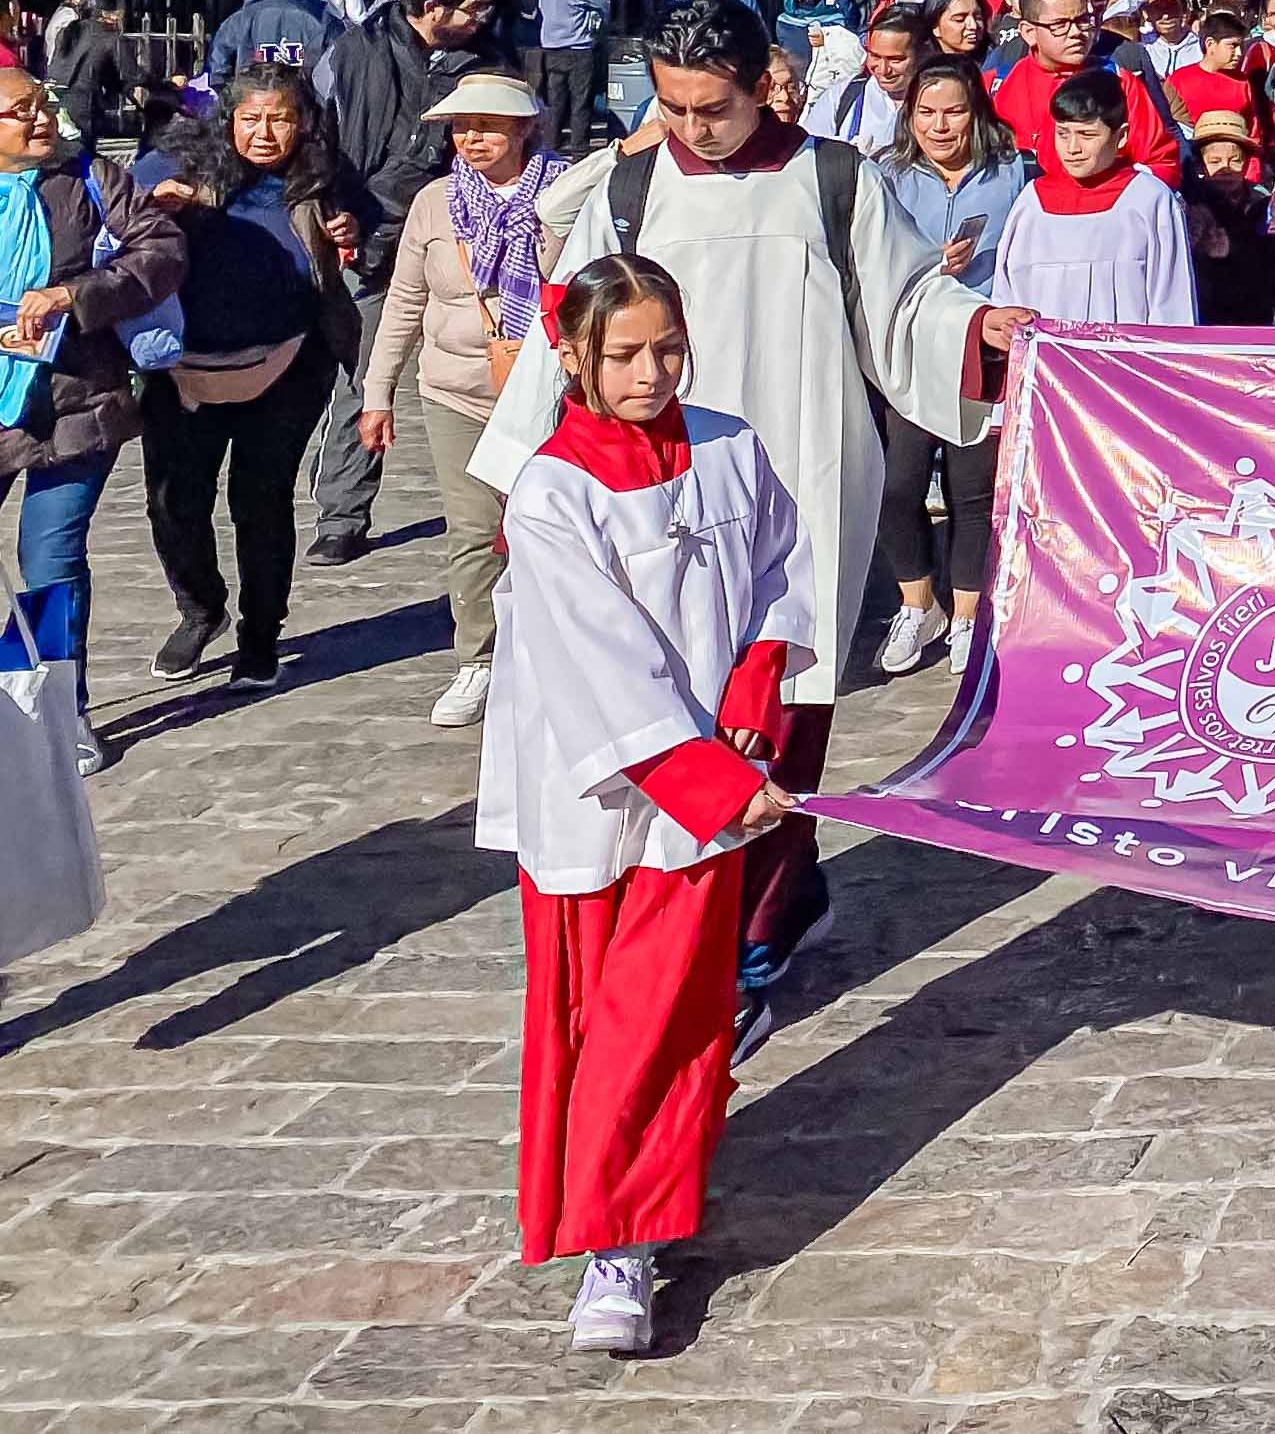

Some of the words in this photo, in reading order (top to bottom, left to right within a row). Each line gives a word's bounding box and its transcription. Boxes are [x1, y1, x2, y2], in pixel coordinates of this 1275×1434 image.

[1188, 639, 1227, 712] salvos
[1216, 588, 1267, 637] fieri
[955, 800, 1186, 866] isto
